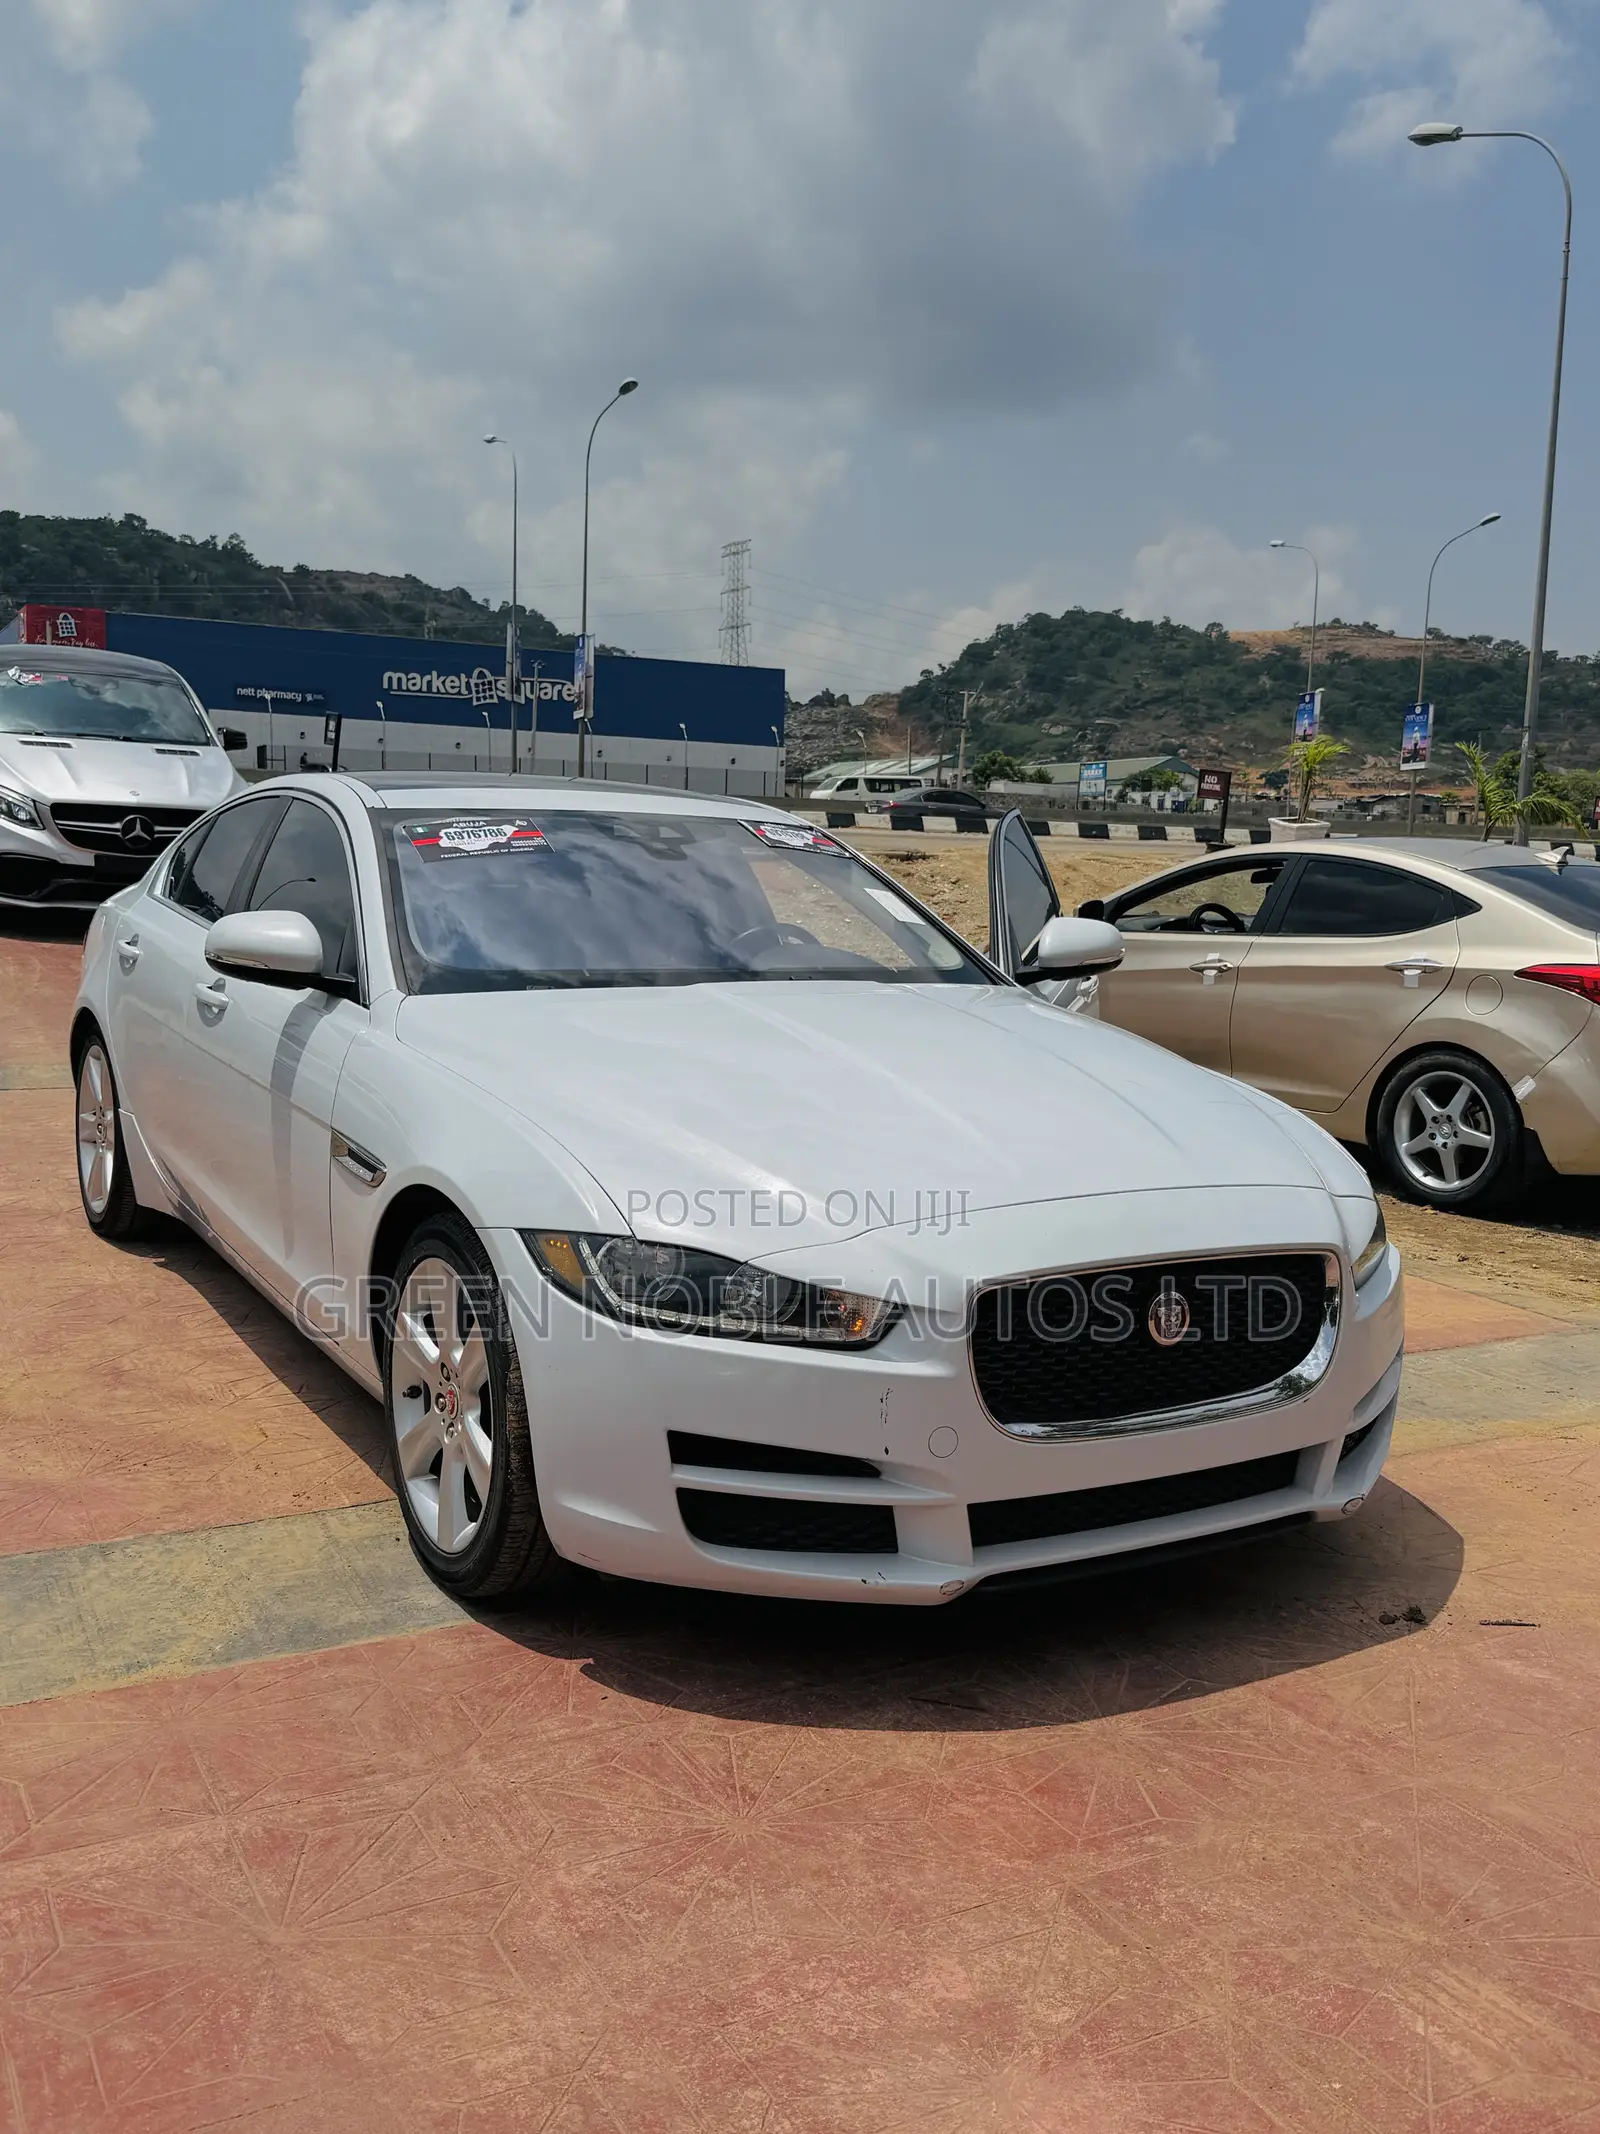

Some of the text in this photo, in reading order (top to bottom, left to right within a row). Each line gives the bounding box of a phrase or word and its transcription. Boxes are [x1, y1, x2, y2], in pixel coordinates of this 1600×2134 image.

[382, 669, 468, 695] market
[236, 687, 255, 696] nett
[256, 688, 302, 702] pharmacy
[1204, 774, 1218, 784] NO
[452, 820, 487, 829] ABUJA
[443, 827, 508, 841] 6976786
